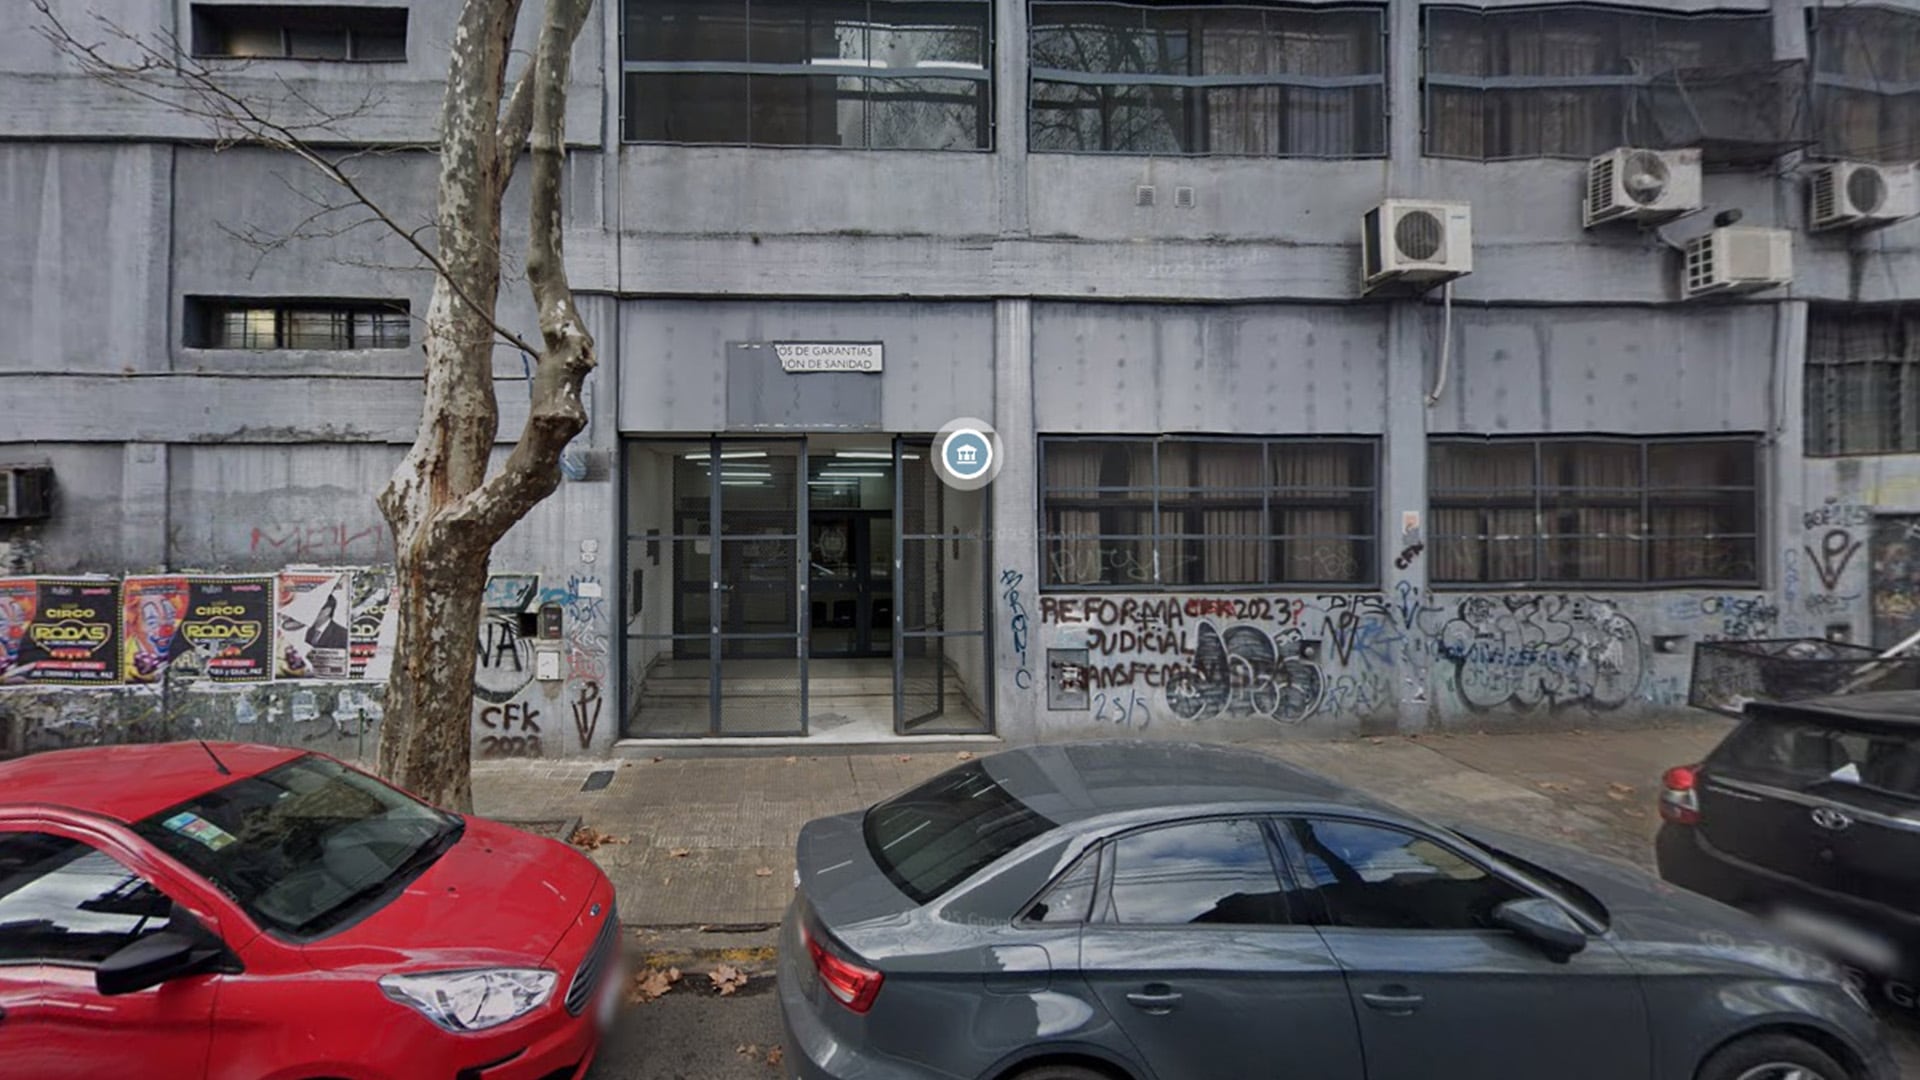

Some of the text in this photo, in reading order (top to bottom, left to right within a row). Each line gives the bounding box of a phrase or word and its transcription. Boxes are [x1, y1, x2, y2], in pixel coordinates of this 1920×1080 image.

[795, 346, 810, 356] DE
[808, 359, 823, 369] DE
[824, 359, 873, 370] SANIDAD
[45, 607, 96, 619] CIRCO
[195, 604, 246, 617] CIRCO
[1040, 596, 1184, 630] REFORMA
[34, 626, 106, 642] RODAS
[186, 624, 256, 638] RODAS
[480, 701, 541, 733] CFK
